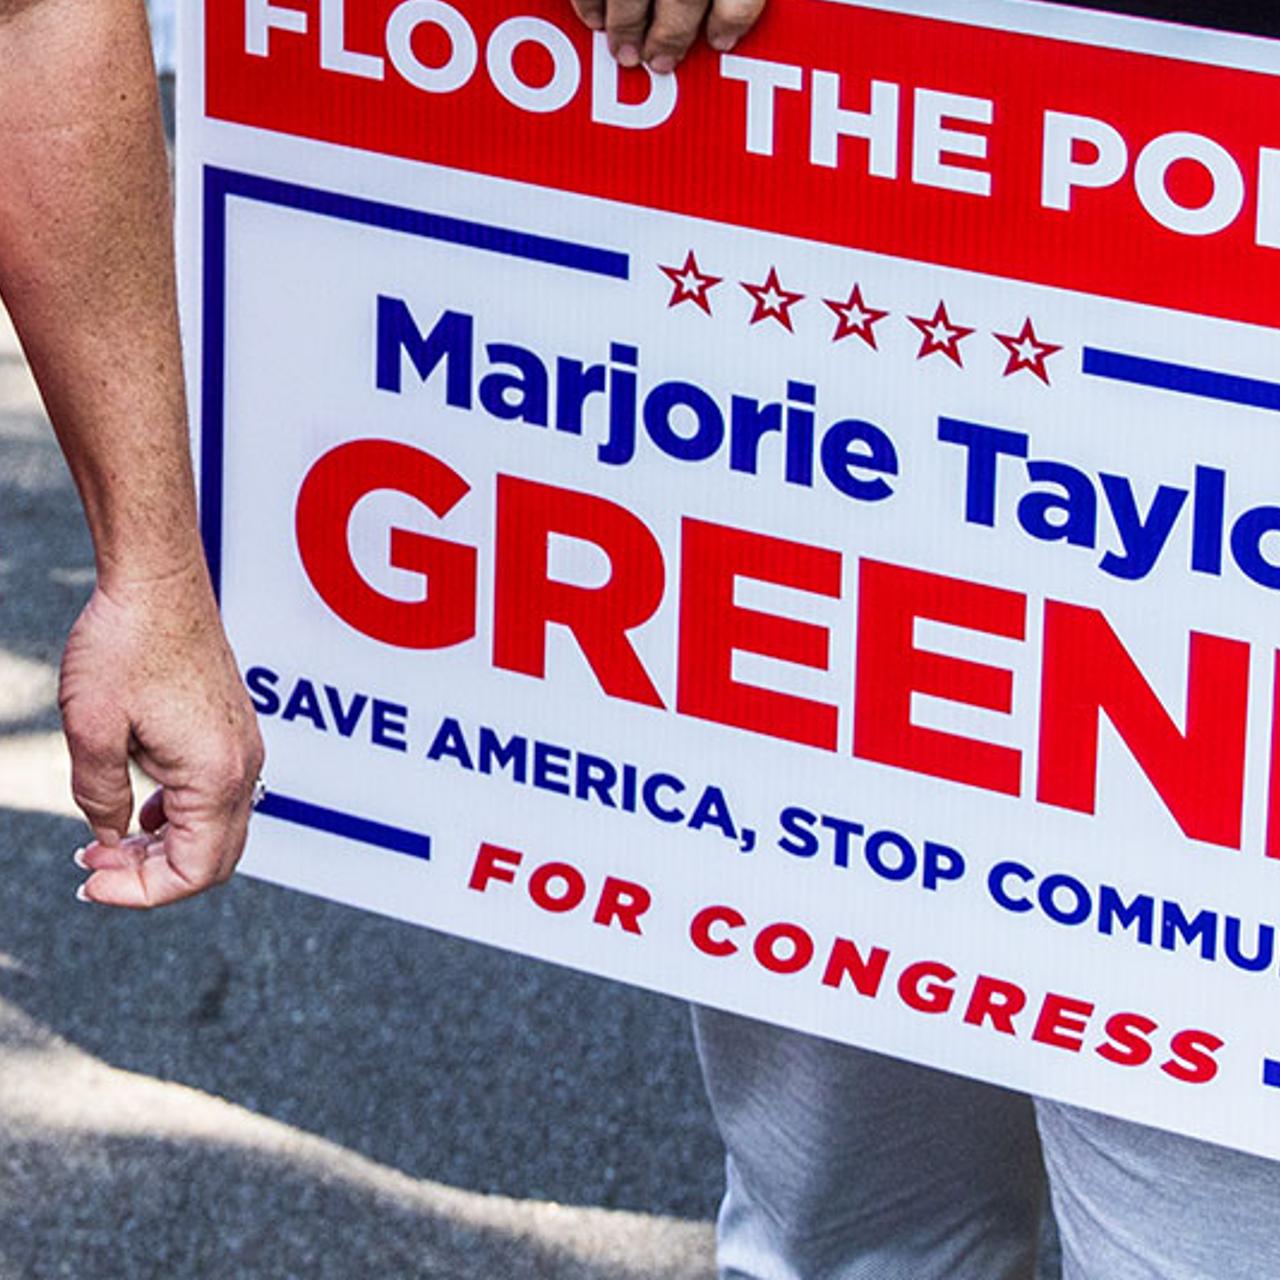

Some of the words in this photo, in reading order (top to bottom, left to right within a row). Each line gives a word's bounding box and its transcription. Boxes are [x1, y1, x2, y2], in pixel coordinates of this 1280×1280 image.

[720, 53, 993, 197] THE
[374, 292, 900, 503] Marjorie
[295, 438, 1280, 860] GREEN
[245, 665, 409, 753] SAVE
[425, 715, 758, 855] AMERICA,
[776, 805, 967, 892] STOP
[986, 860, 1280, 980] COMMU
[469, 843, 651, 935] FOR
[690, 906, 1224, 1084] CONGRESS
